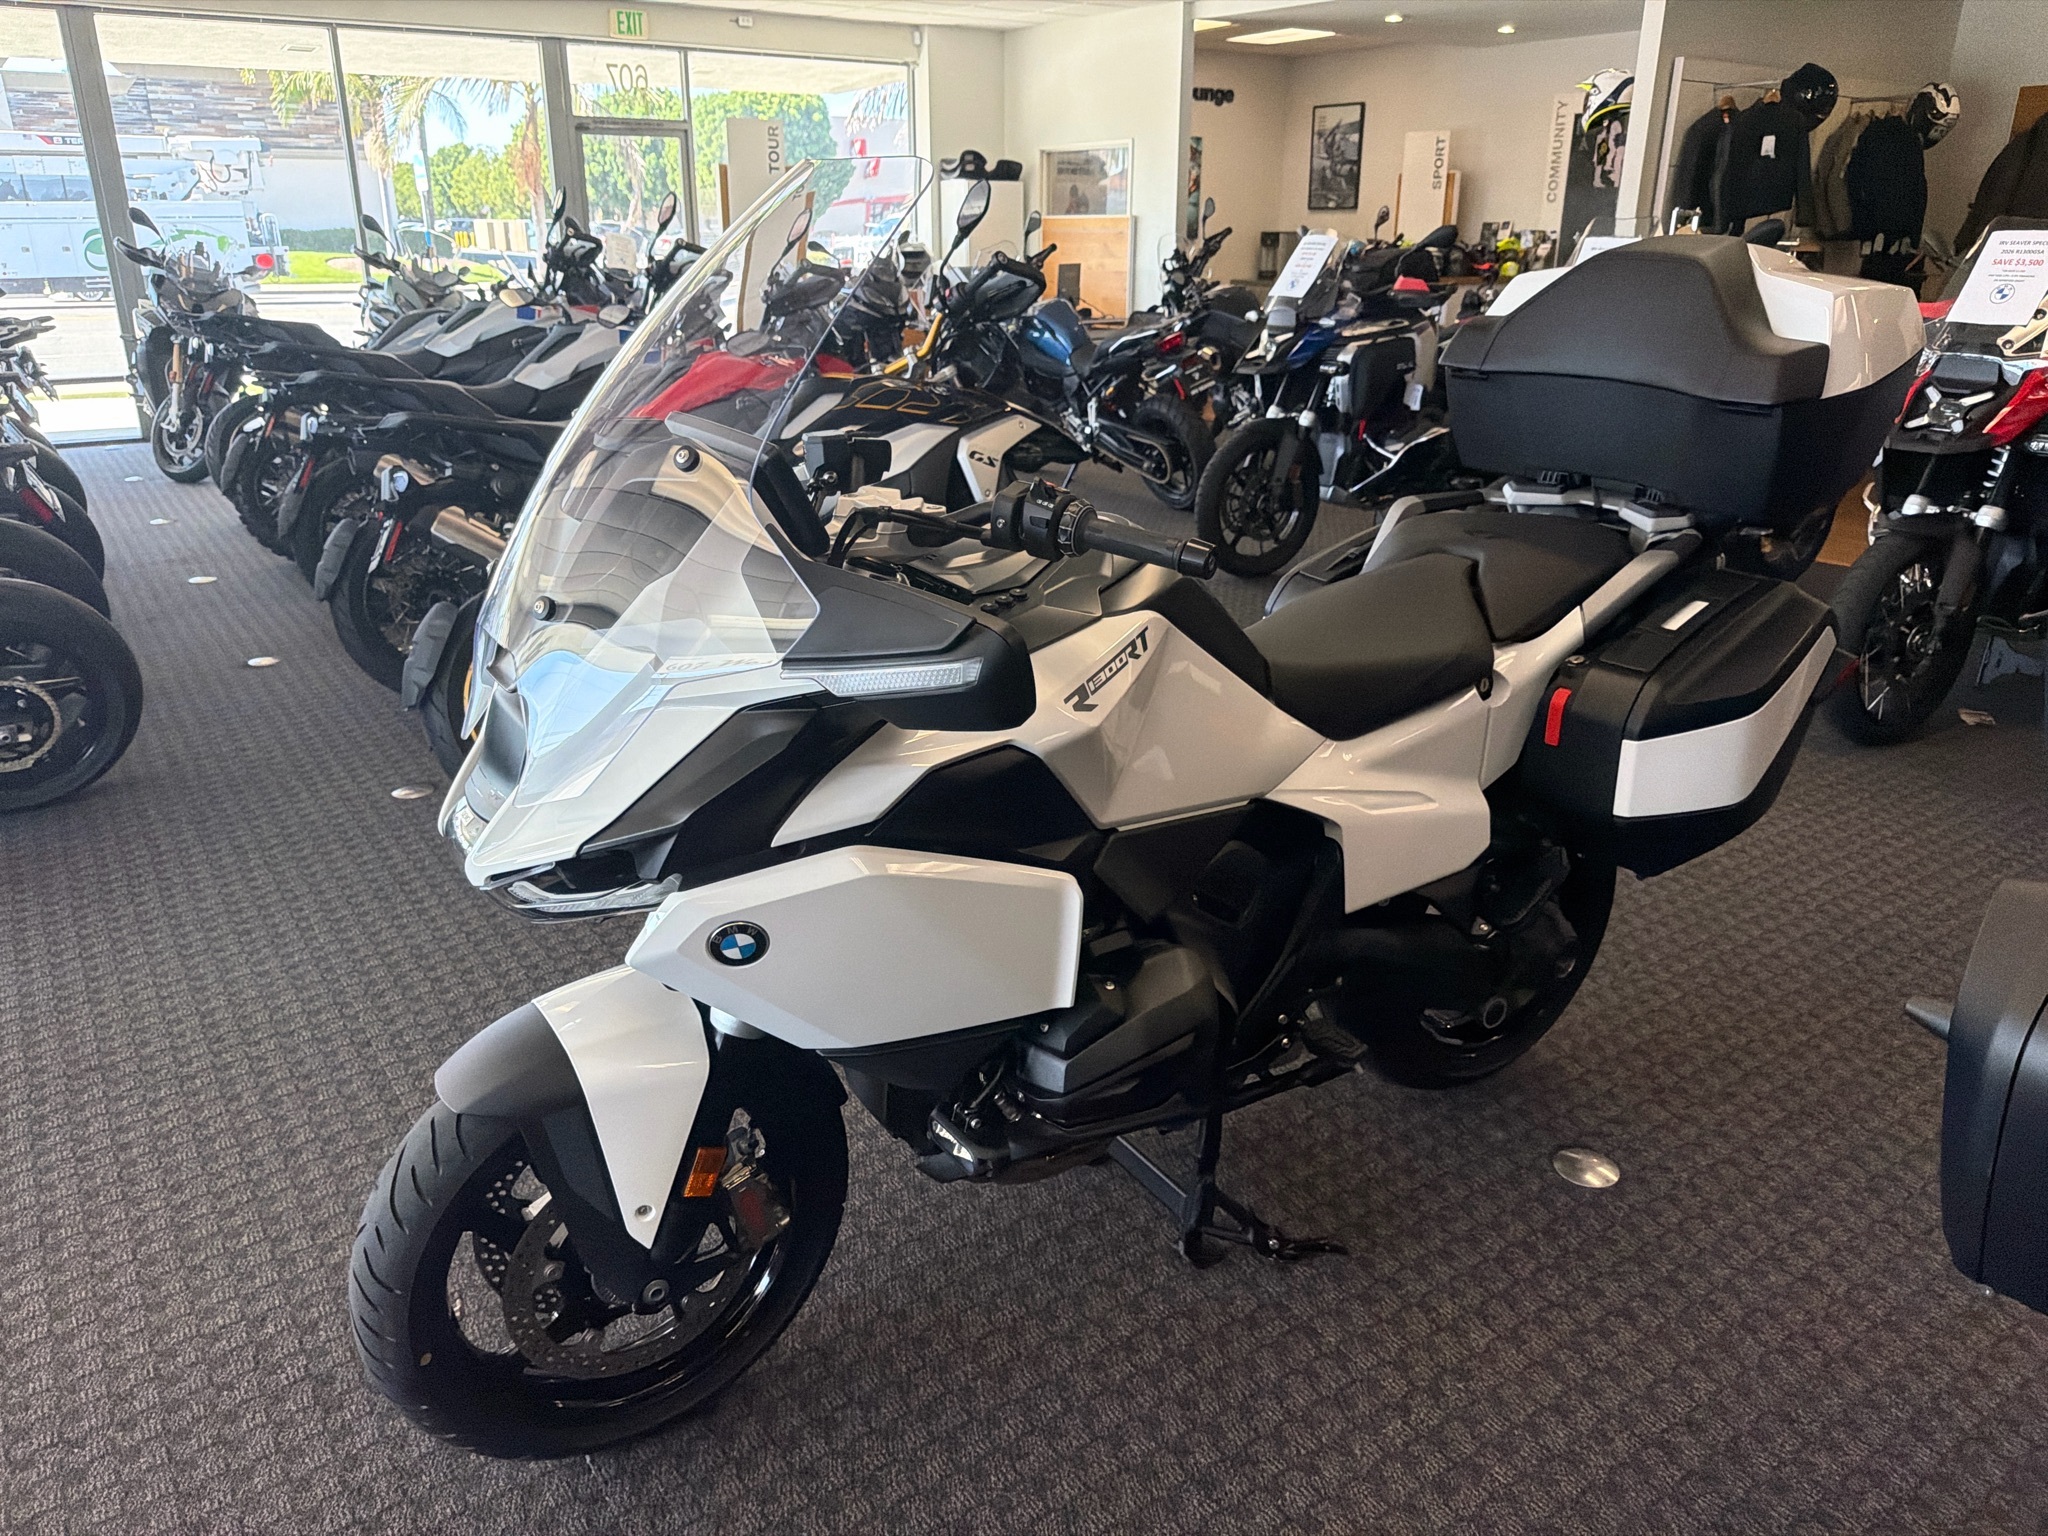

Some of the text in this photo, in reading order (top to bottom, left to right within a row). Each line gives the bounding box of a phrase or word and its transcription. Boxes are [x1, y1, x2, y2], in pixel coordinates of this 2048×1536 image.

[616, 10, 643, 36] EXIT
[768, 125, 780, 174] TOUR
[1432, 136, 1446, 190] SPORT
[1546, 100, 1569, 203] COMMUNITY
[2015, 258, 2045, 267] $3,500
[969, 450, 999, 468] GS
